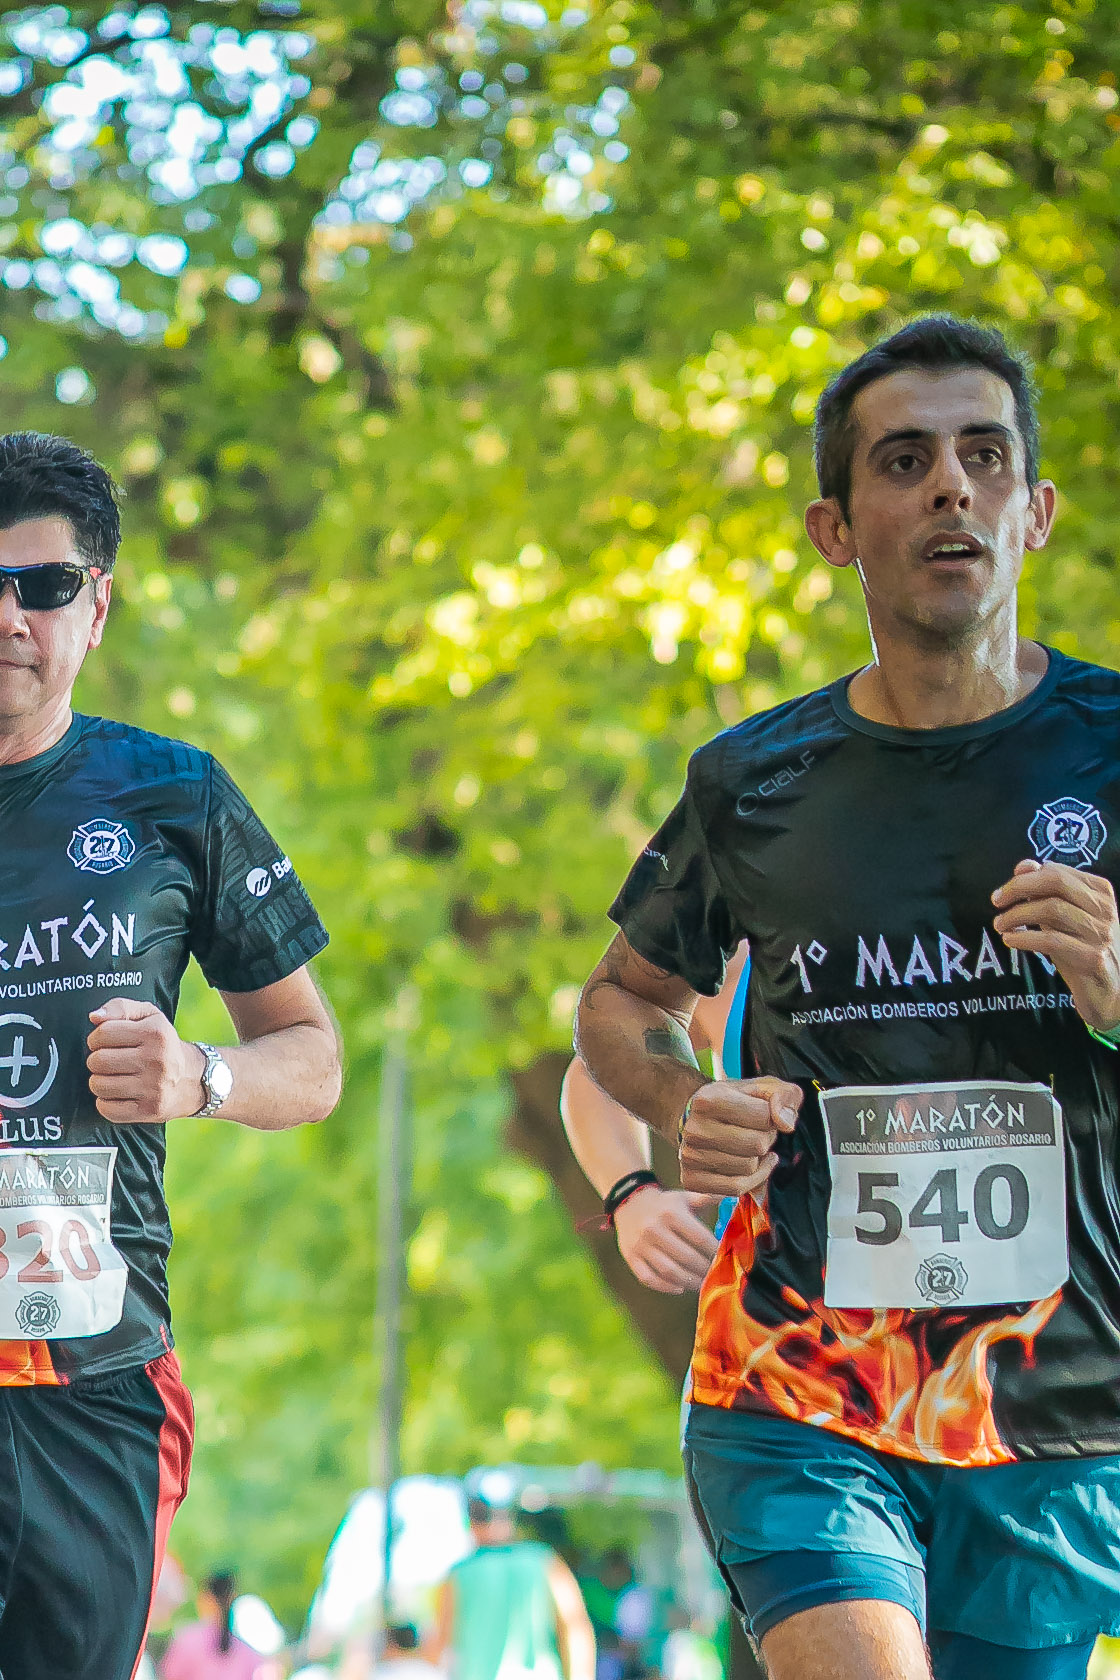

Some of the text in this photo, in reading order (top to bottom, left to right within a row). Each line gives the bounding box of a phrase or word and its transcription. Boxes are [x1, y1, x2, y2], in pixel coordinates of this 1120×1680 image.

[1054, 817, 1084, 842] 27
[90, 835, 116, 854] 27
[96, 971, 143, 988] ROSARIO
[791, 1002, 869, 1026] ASOCIACIÓN
[871, 1001, 959, 1019] BOMBEROS
[884, 1094, 1026, 1136] MARATÓN
[887, 1139, 940, 1154] BOMBEROS
[942, 1134, 1007, 1150] VOLUNTARIOS
[1009, 1132, 1052, 1146] ROSARIO
[854, 1163, 1030, 1246] 540
[932, 1269, 953, 1288] 27
[30, 1305, 48, 1321] 27
